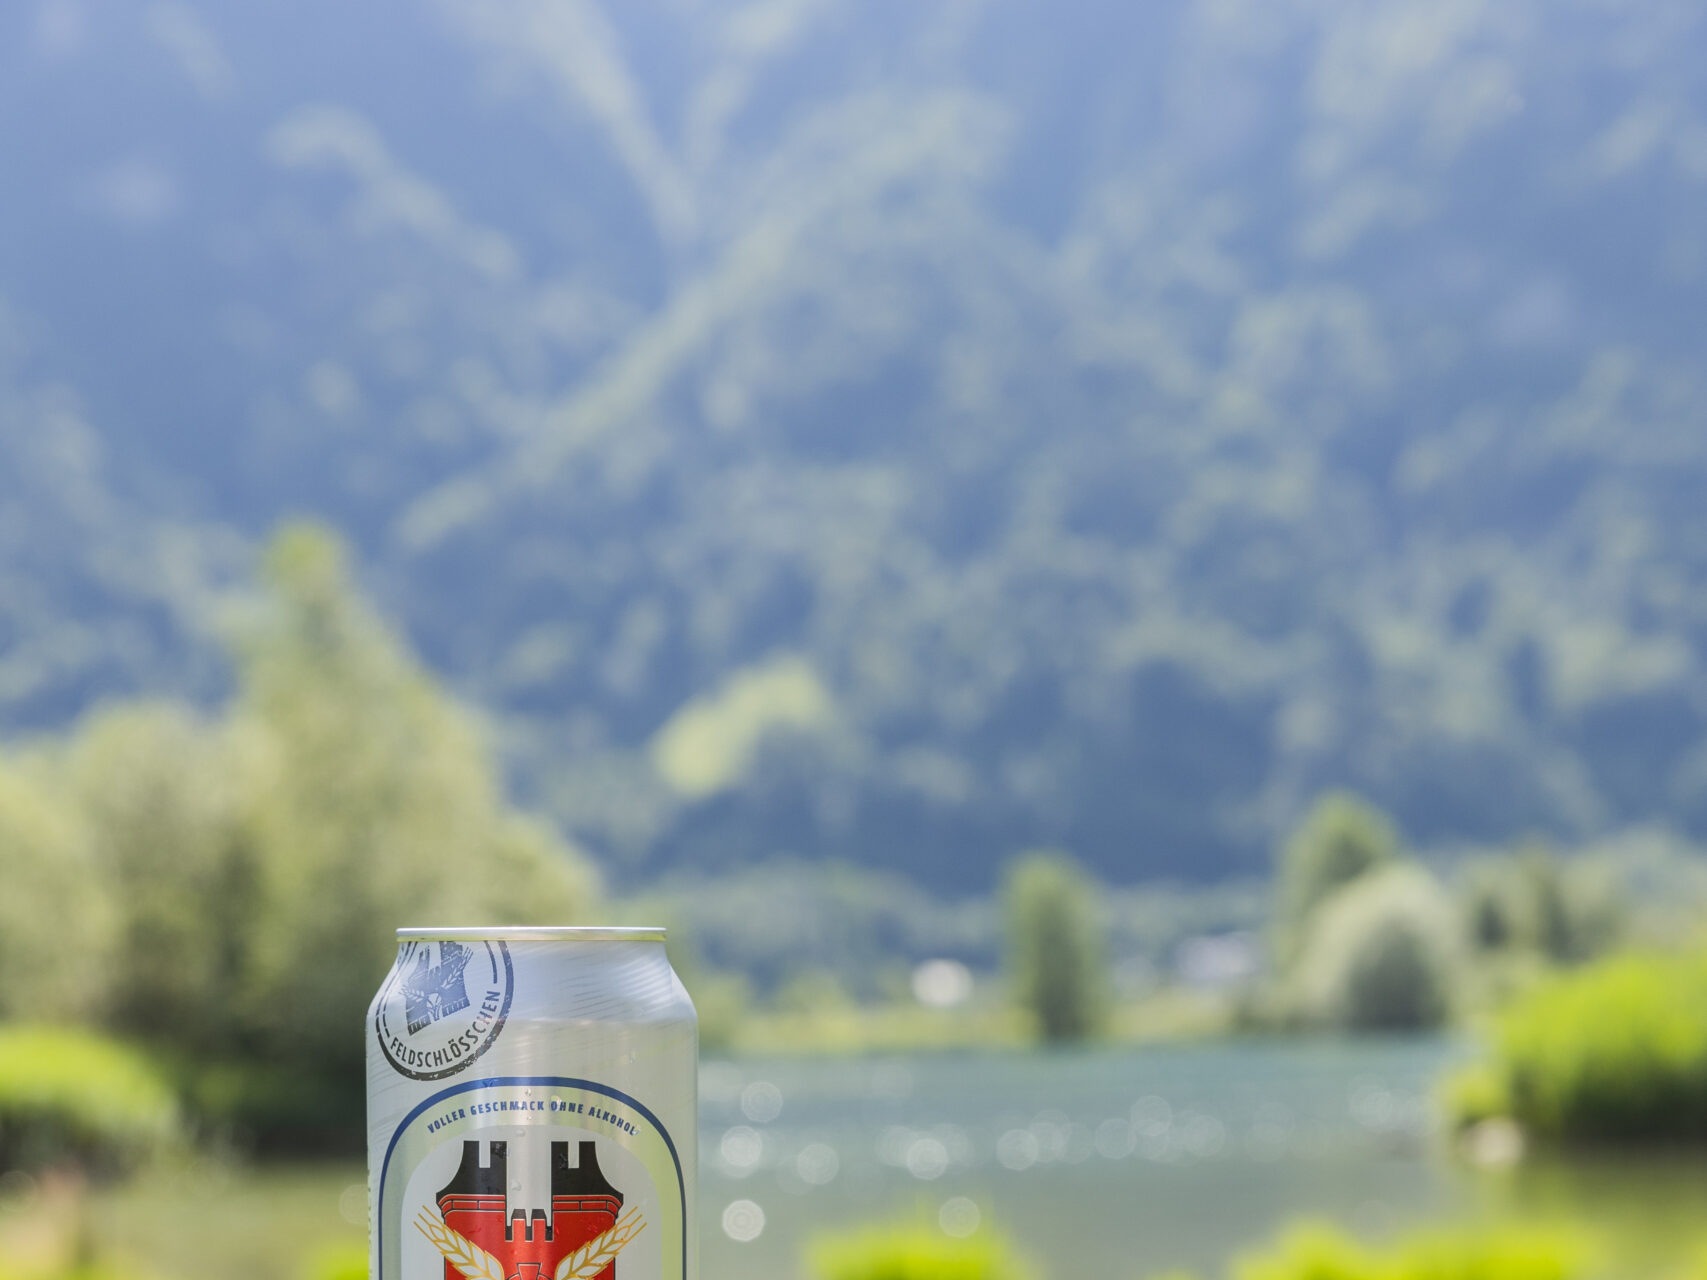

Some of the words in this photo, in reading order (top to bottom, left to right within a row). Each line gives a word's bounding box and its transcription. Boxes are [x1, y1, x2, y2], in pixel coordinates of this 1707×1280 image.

[390, 990, 500, 1068] FELDSCHLÖSSCHEN
[427, 1108, 466, 1133] VOLLER
[470, 1101, 544, 1116] GESCHMACK
[550, 1101, 584, 1115] OHNE
[588, 1106, 636, 1136] ALKOHOL
